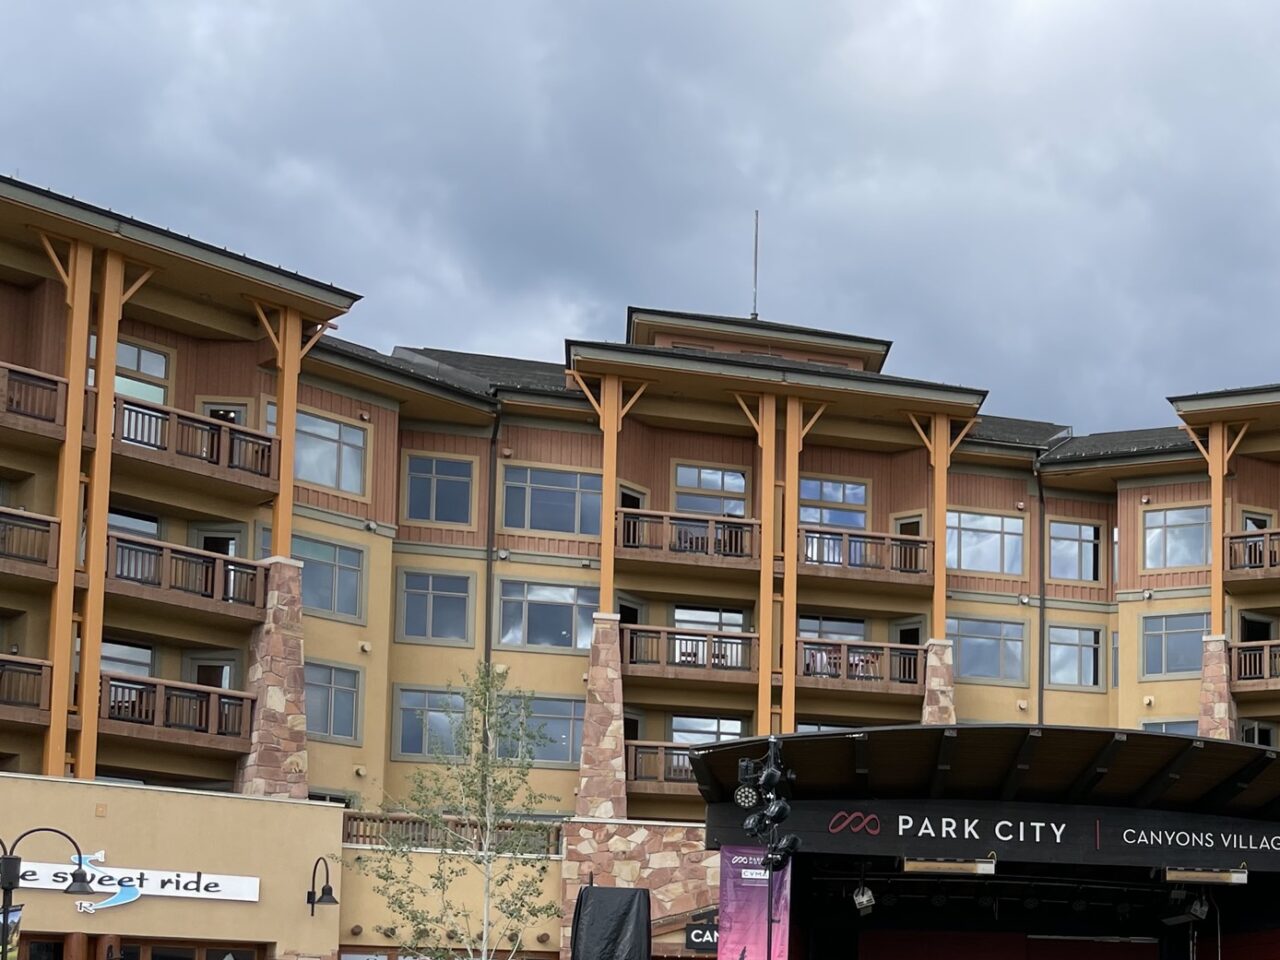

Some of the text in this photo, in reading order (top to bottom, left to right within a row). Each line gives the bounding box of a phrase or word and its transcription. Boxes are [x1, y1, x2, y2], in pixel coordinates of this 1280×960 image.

[898, 815, 1066, 843] PARK CITY
[1123, 828, 1214, 847] CANYONS
[160, 871, 222, 893] ride
